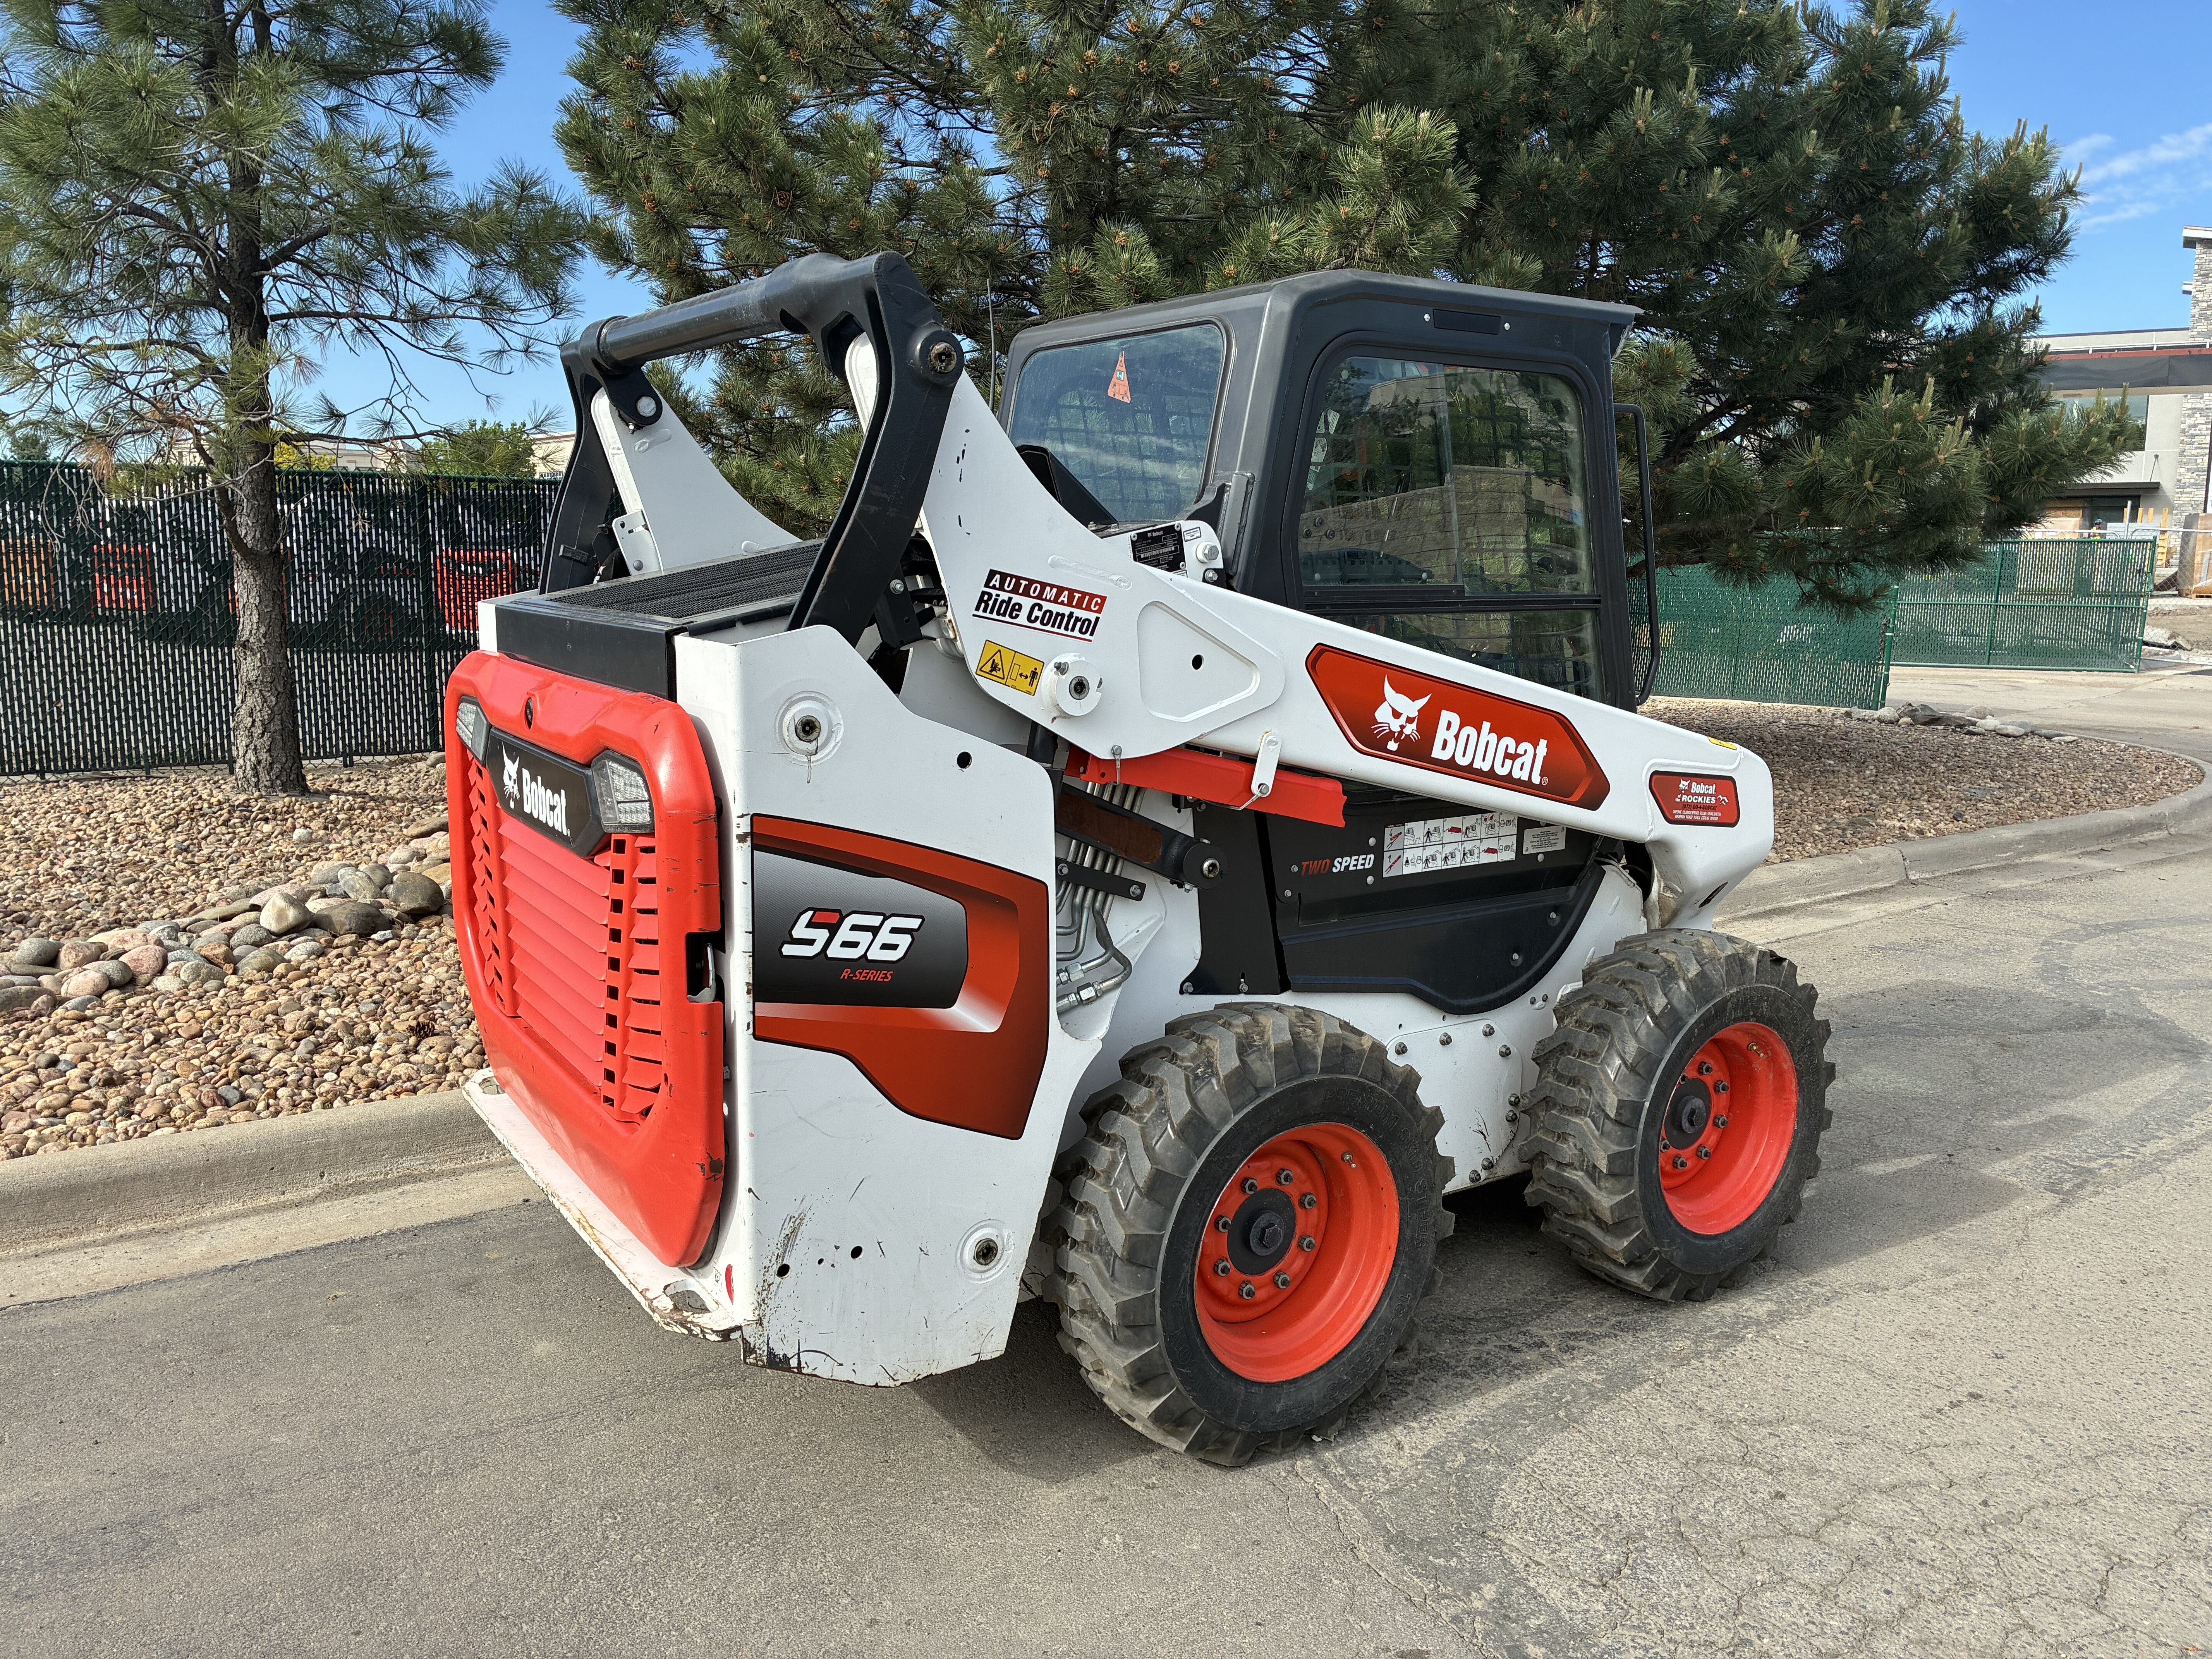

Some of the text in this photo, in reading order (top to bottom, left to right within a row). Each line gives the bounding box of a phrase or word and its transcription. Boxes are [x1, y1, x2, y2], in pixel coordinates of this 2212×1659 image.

[989, 574, 1102, 611] AUTOMATIC
[975, 591, 1100, 637] Ride Control
[1431, 709, 1547, 785] Bobcat
[522, 768, 567, 836] Bobcat
[1681, 795, 1716, 804] ROCKIES
[1691, 782, 1716, 795] Bobcat
[1301, 854, 1375, 876] TWO SPEED
[780, 908, 925, 962] S66
[840, 968, 894, 982] R-SERIES
[1322, 1086, 1429, 1249] PREMIUM SKID STEER
